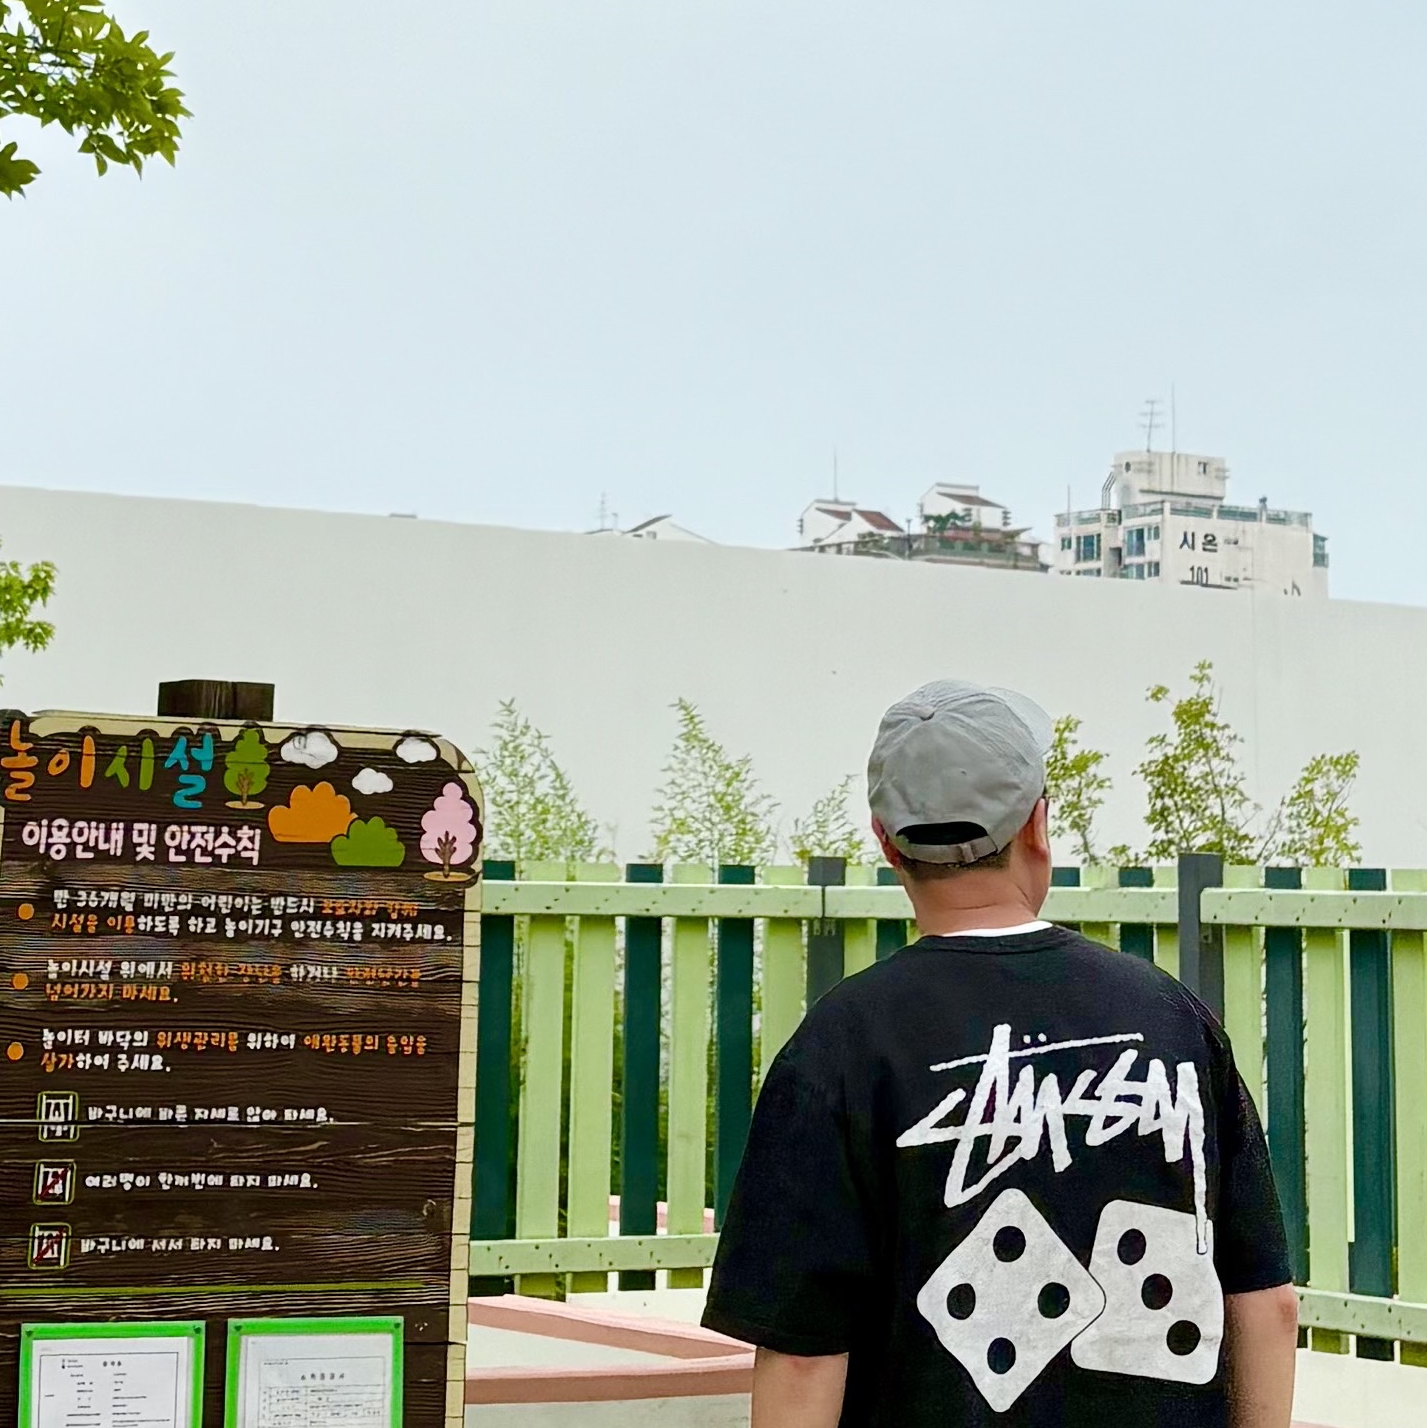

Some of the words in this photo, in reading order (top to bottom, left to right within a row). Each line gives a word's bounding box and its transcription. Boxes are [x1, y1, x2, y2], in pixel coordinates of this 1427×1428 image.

[0, 719, 215, 810] 놀이시설
[22, 818, 125, 861] 이용안내
[132, 822, 157, 862] 및
[164, 824, 262, 866] 안전수칙
[76, 890, 136, 912] 36개월
[143, 892, 193, 912] 미만의
[201, 894, 263, 915] 어린이는
[270, 896, 314, 915] 반드시
[50, 912, 99, 934] 시설을
[106, 913, 180, 936] 이용하도록
[187, 915, 218, 934] 하고
[224, 916, 283, 938] 놀이기구
[290, 919, 364, 941] 안전수칙을
[371, 922, 453, 942] 지켜주세요.
[119, 960, 174, 979] 위에서
[121, 983, 179, 1003] 마세요.
[41, 1028, 90, 1050] 놀이터
[97, 1029, 149, 1050] 바닥의
[156, 1031, 239, 1052] 위생관리를
[246, 1032, 296, 1050] 위하여
[303, 1033, 380, 1055] 애완동물의
[40, 1052, 110, 1073] 삼가하여
[116, 1054, 172, 1073] 주세요.
